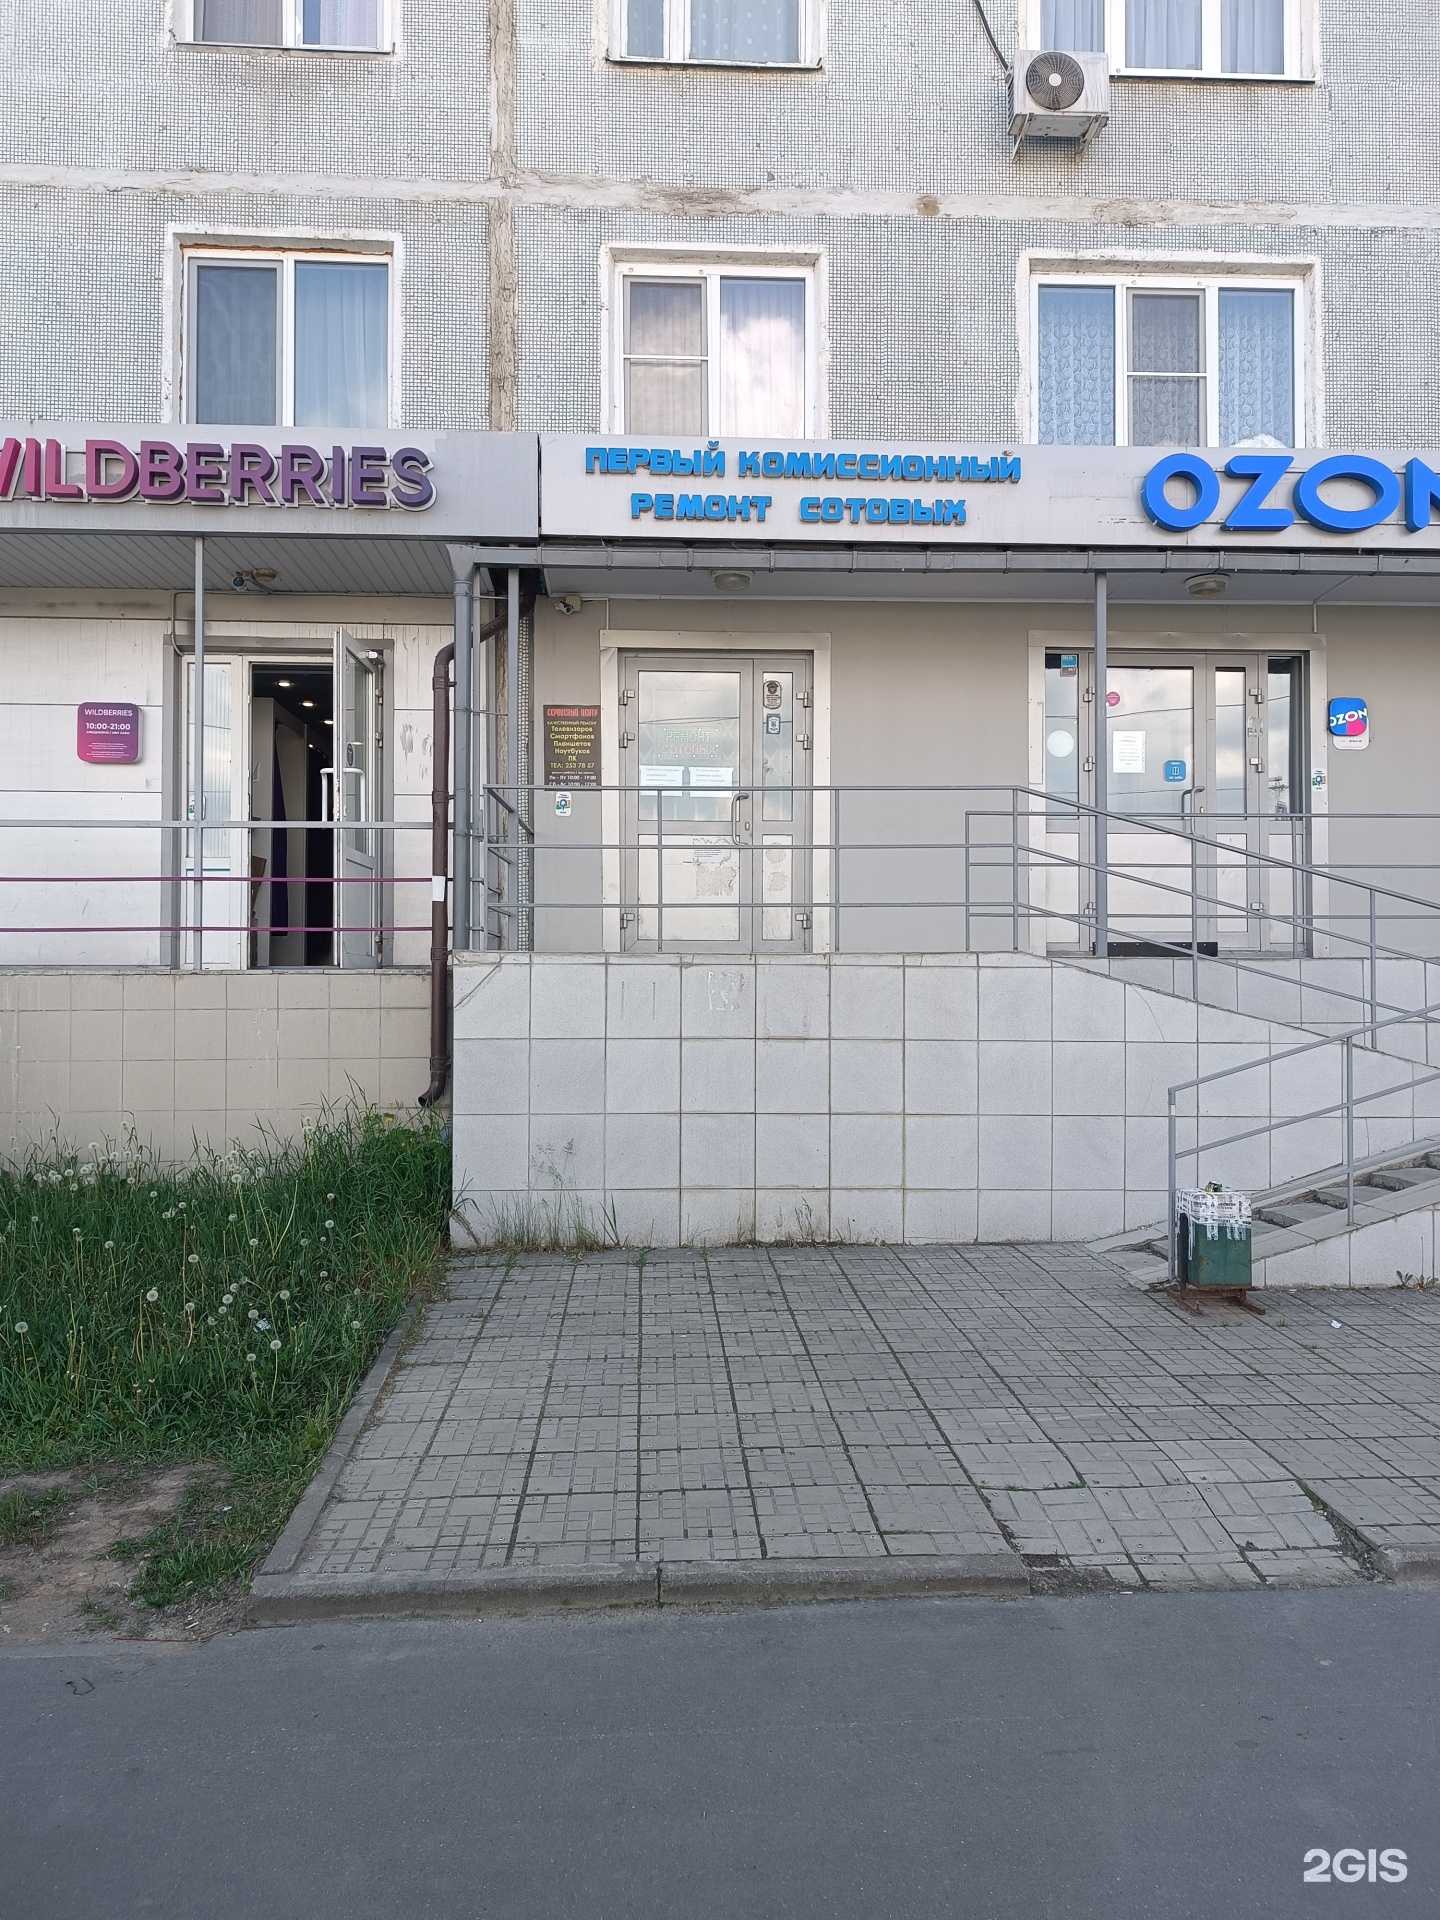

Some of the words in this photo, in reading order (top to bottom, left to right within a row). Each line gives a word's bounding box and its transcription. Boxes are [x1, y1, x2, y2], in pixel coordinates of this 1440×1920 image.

[585, 440, 726, 478] ПЕРВЫЙ
[738, 450, 1022, 484] КОМИССИОННЫЙ
[630, 492, 773, 523] РЕМОНТ
[799, 496, 968, 526] СОТОВЫХ
[84, 708, 133, 717] WILDBERRIES
[86, 722, 131, 730] 10:00-21:00
